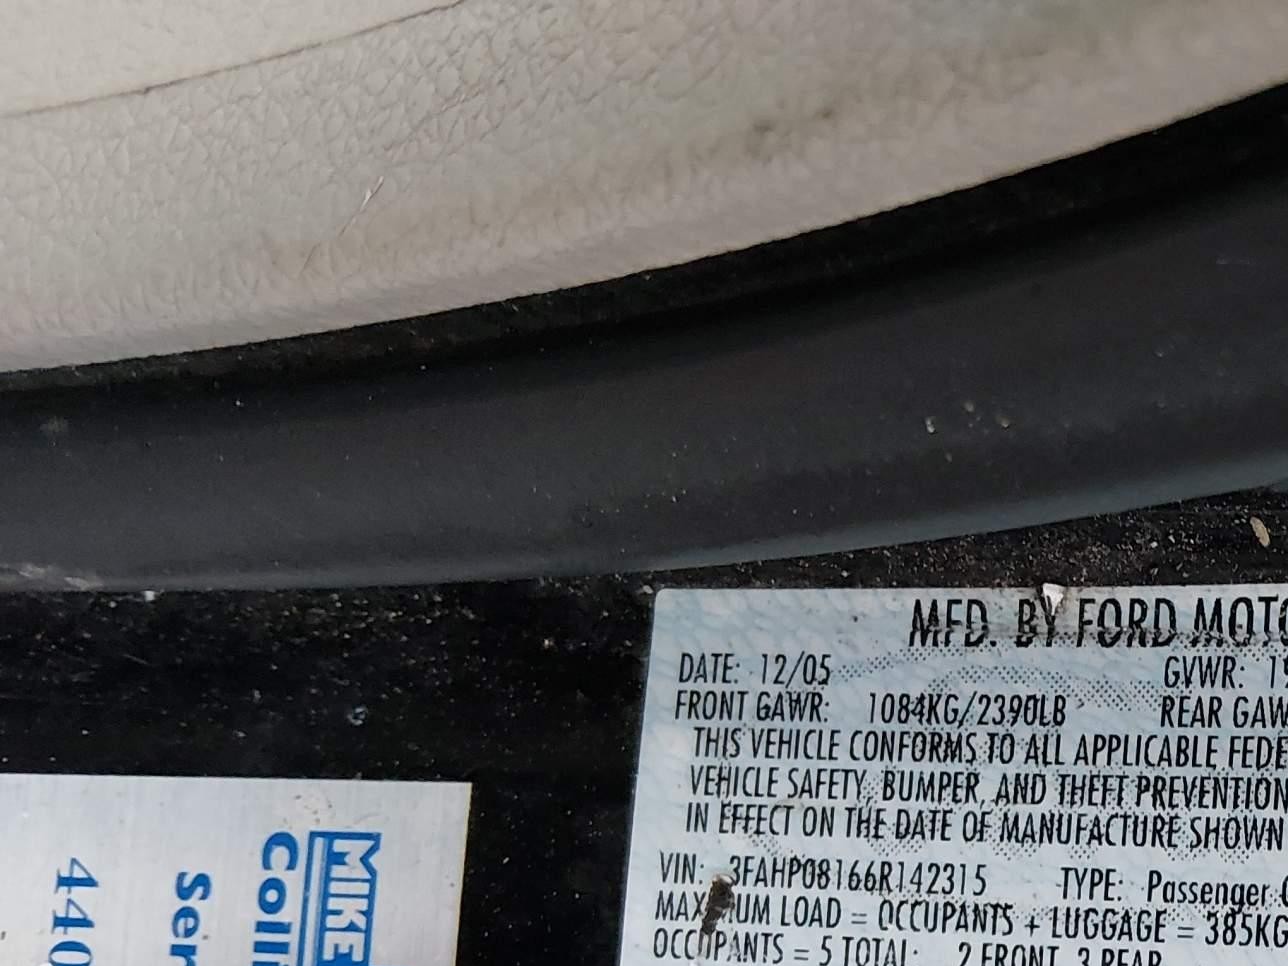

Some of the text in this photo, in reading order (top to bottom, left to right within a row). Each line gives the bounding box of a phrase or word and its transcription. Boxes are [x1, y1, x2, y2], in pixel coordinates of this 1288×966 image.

[908, 600, 998, 648] MFD.
[1016, 599, 1057, 648] BY
[1076, 598, 1175, 649] FORD
[678, 652, 740, 684] DATE:
[761, 652, 832, 688] 12/05
[1163, 654, 1245, 690] GVWR:
[675, 691, 745, 723] FRONT
[756, 691, 829, 724] GAWR:
[869, 692, 1066, 728] 1084KG/2390LB
[1160, 697, 1221, 730] REAR
[693, 728, 740, 759] THIS
[751, 729, 839, 761] VEHICLE
[849, 731, 977, 764] CONFORMS
[988, 733, 1015, 764] TO
[1024, 733, 1064, 765] ALL
[1073, 734, 1216, 769] APPLICABLE
[690, 767, 780, 799] VEHICLE
[995, 773, 1047, 805] AND
[1057, 774, 1127, 806] THEFT
[686, 802, 709, 833] IN
[718, 804, 794, 836] EFFECT
[802, 805, 835, 838] ON
[844, 807, 887, 840] THE
[895, 808, 953, 842] DATE
[962, 810, 992, 842] OF
[999, 810, 1180, 848] MANUFACTURE
[1189, 817, 1285, 852] SHOWN
[323, 838, 374, 963] MIKE
[660, 851, 704, 885] VIN:
[729, 854, 987, 896] 3FAHP08166R142315
[1062, 867, 1123, 901] TYPE:
[1147, 869, 1271, 914] Passenger
[655, 890, 770, 925] MAXUM
[780, 895, 841, 929] LOAD
[851, 911, 868, 927] =
[879, 901, 1014, 936] OCCUPANTS
[1023, 917, 1037, 934] +
[1051, 907, 1167, 943] LUGGAGE
[1178, 925, 1194, 941] =
[794, 948, 810, 961] =
[819, 935, 833, 966] 5
